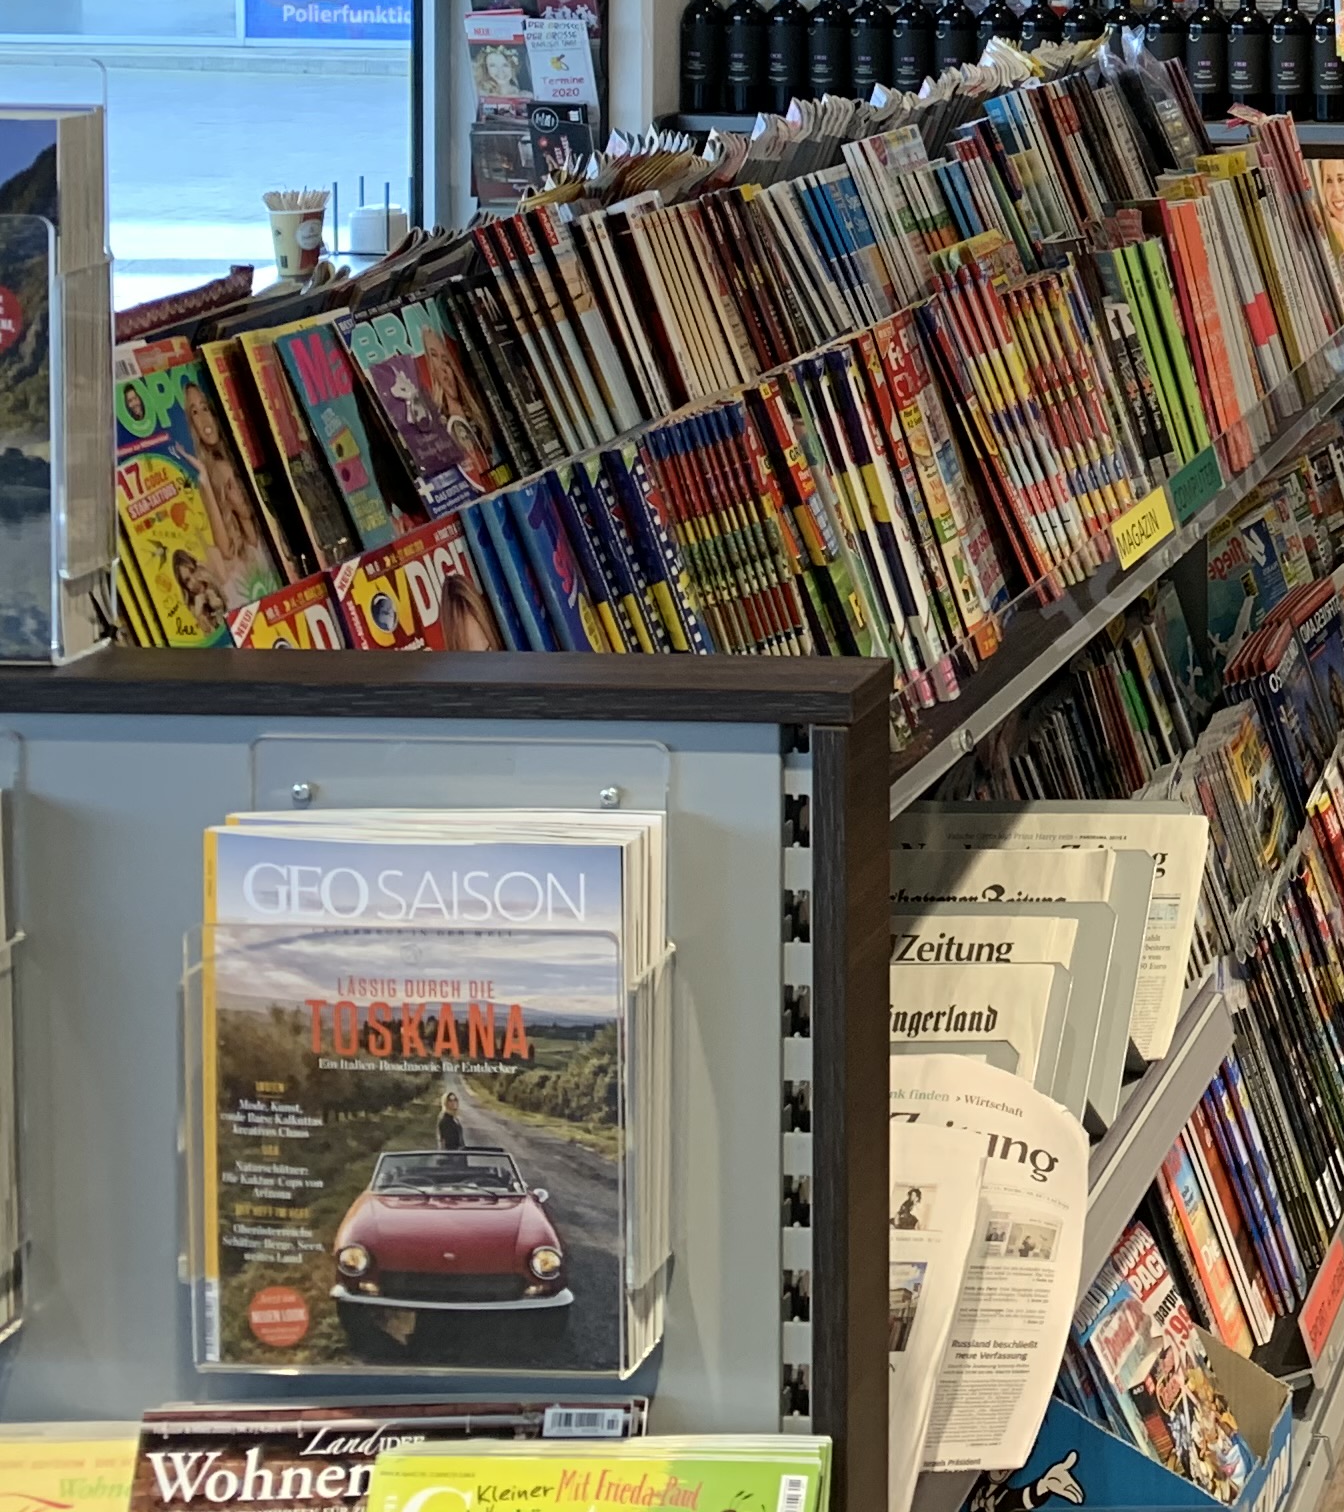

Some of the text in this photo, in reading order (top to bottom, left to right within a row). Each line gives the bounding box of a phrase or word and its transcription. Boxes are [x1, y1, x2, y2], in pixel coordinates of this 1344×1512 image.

[541, 76, 585, 86] Termine
[551, 88, 581, 98] 2020
[1115, 509, 1160, 560] MAGAZIN
[242, 860, 586, 923] GEO SAISON
[893, 932, 1015, 963] Zeitung
[337, 975, 496, 999] LÄSSIG DURCH DIE
[304, 999, 531, 1060] TOSKANA
[908, 1088, 950, 1103] finden
[963, 1093, 1024, 1118] Wirtschaft
[951, 1338, 1039, 1351] Russland beschließt
[955, 1350, 1028, 1362] neue Verfassung
[477, 1484, 553, 1504] Kleiner
[556, 1468, 589, 1503] Mit
